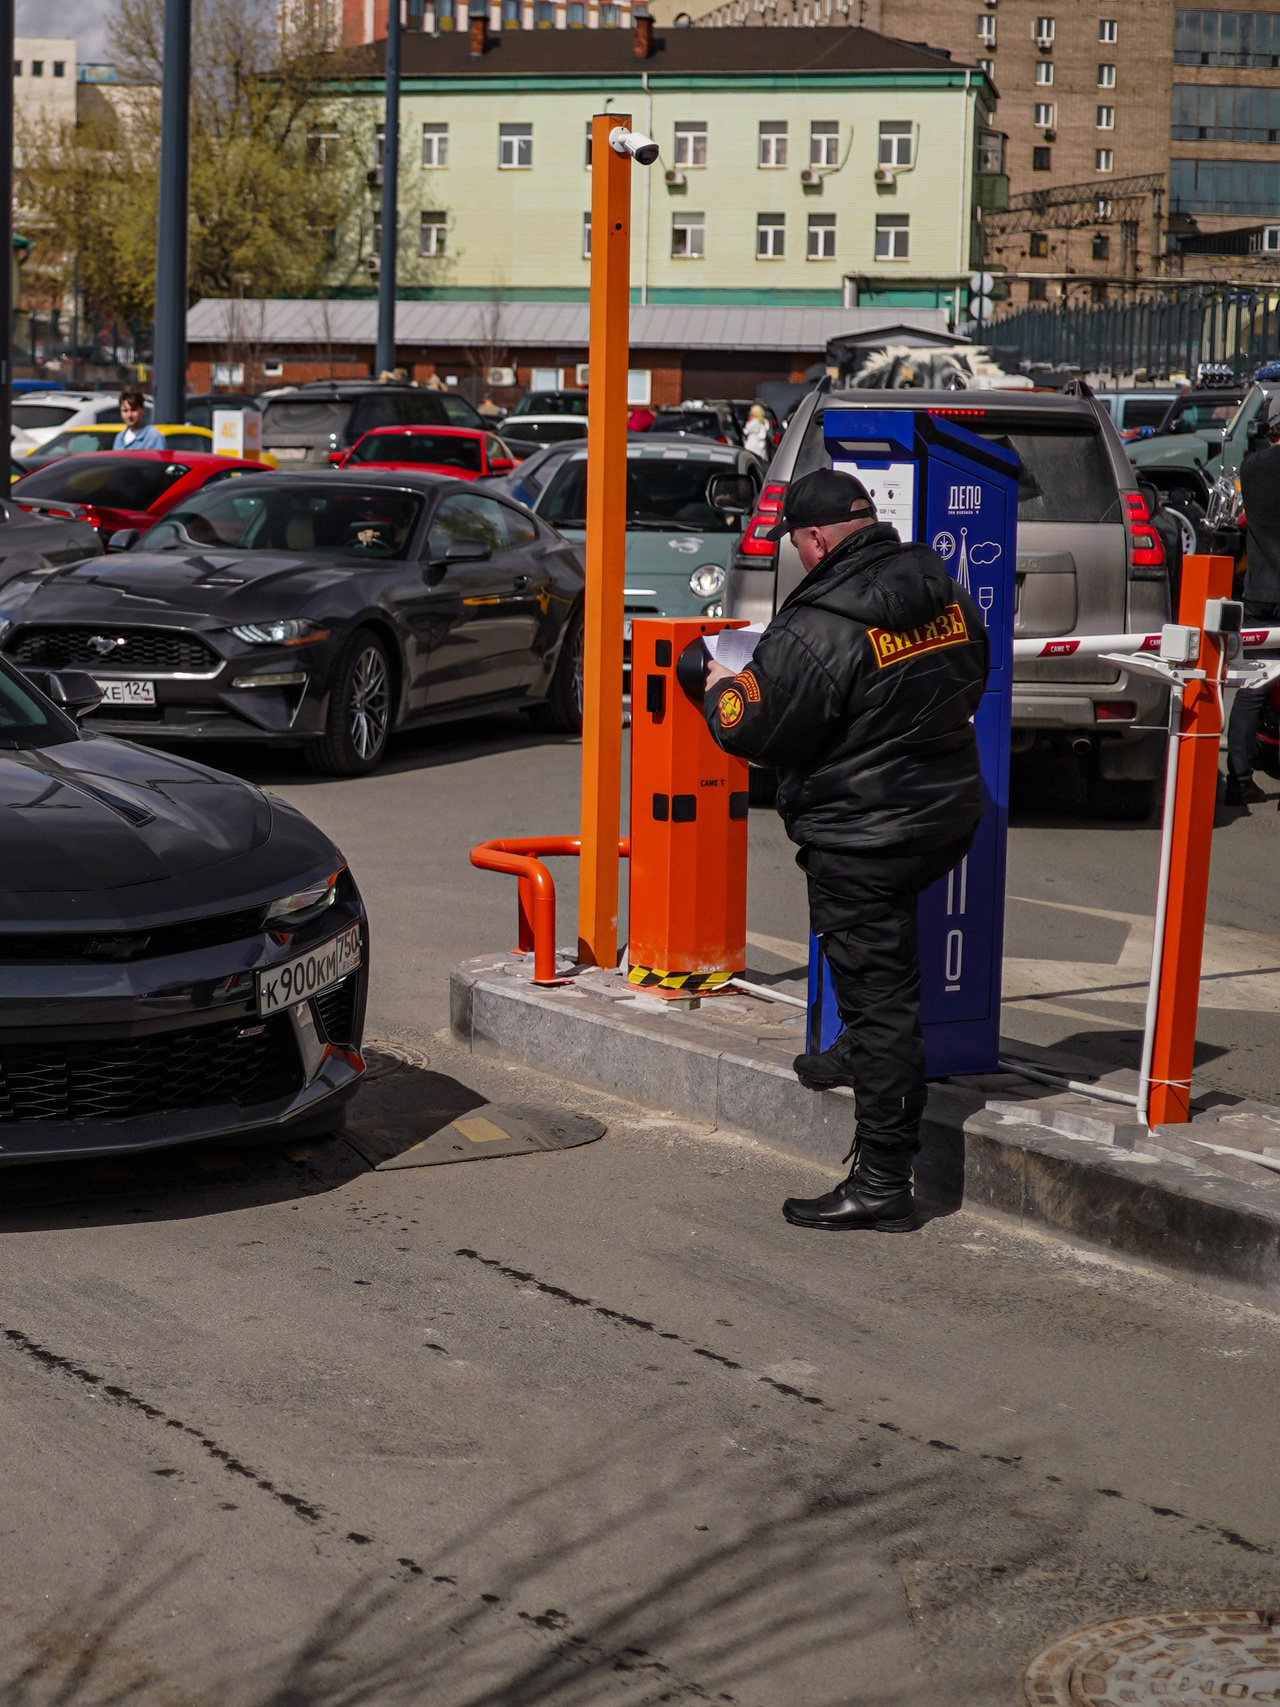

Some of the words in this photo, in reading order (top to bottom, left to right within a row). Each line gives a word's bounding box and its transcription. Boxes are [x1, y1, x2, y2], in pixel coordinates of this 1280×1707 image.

[948, 486, 981, 509] ДЕПО
[1050, 645, 1065, 653] CAME
[1149, 639, 1161, 647] CAM
[101, 686, 121, 700] ХЕ
[124, 681, 150, 696] 124
[700, 779, 718, 787] CAME
[266, 949, 336, 1009] К900КМ
[337, 927, 357, 963] 750
